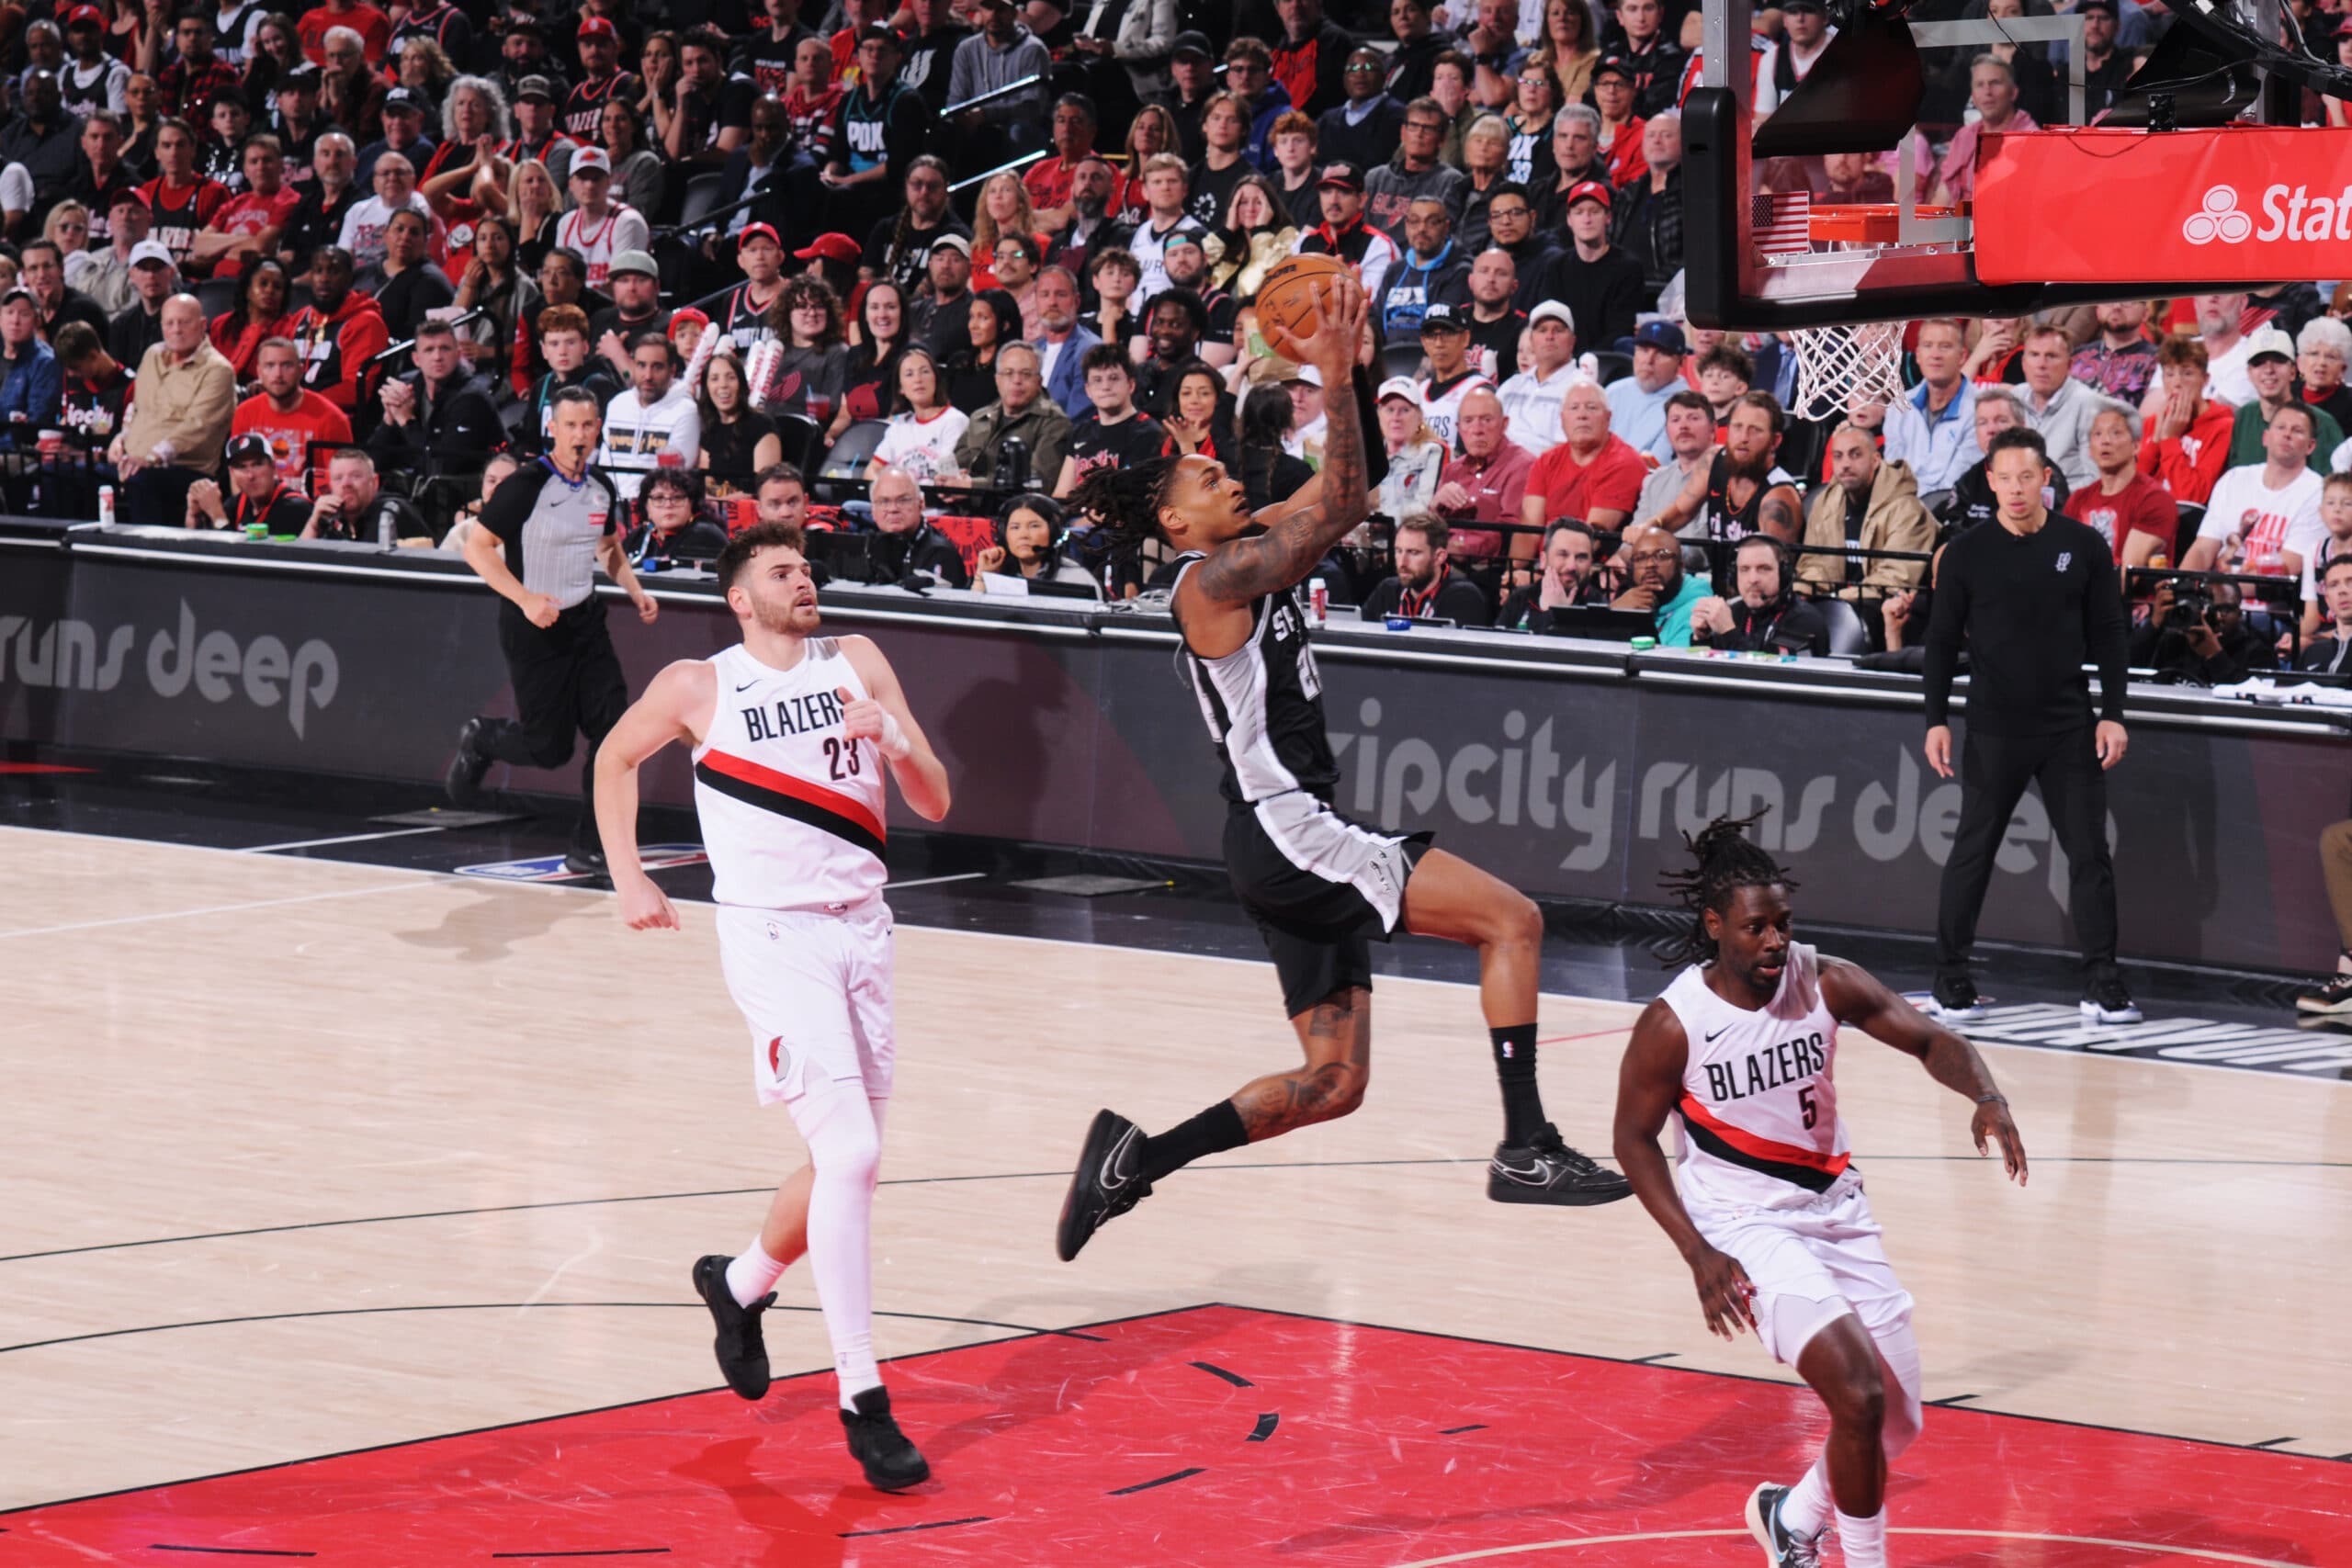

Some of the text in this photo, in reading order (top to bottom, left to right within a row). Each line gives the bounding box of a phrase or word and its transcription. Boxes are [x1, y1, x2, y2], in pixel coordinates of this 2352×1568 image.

[2256, 184, 2352, 242] Stat
[147, 596, 339, 741] deep
[822, 736, 861, 782] 23
[1639, 761, 1837, 853] runs
[1702, 1032, 1825, 1102] BLAZERS
[1798, 1084, 1817, 1131] 5
